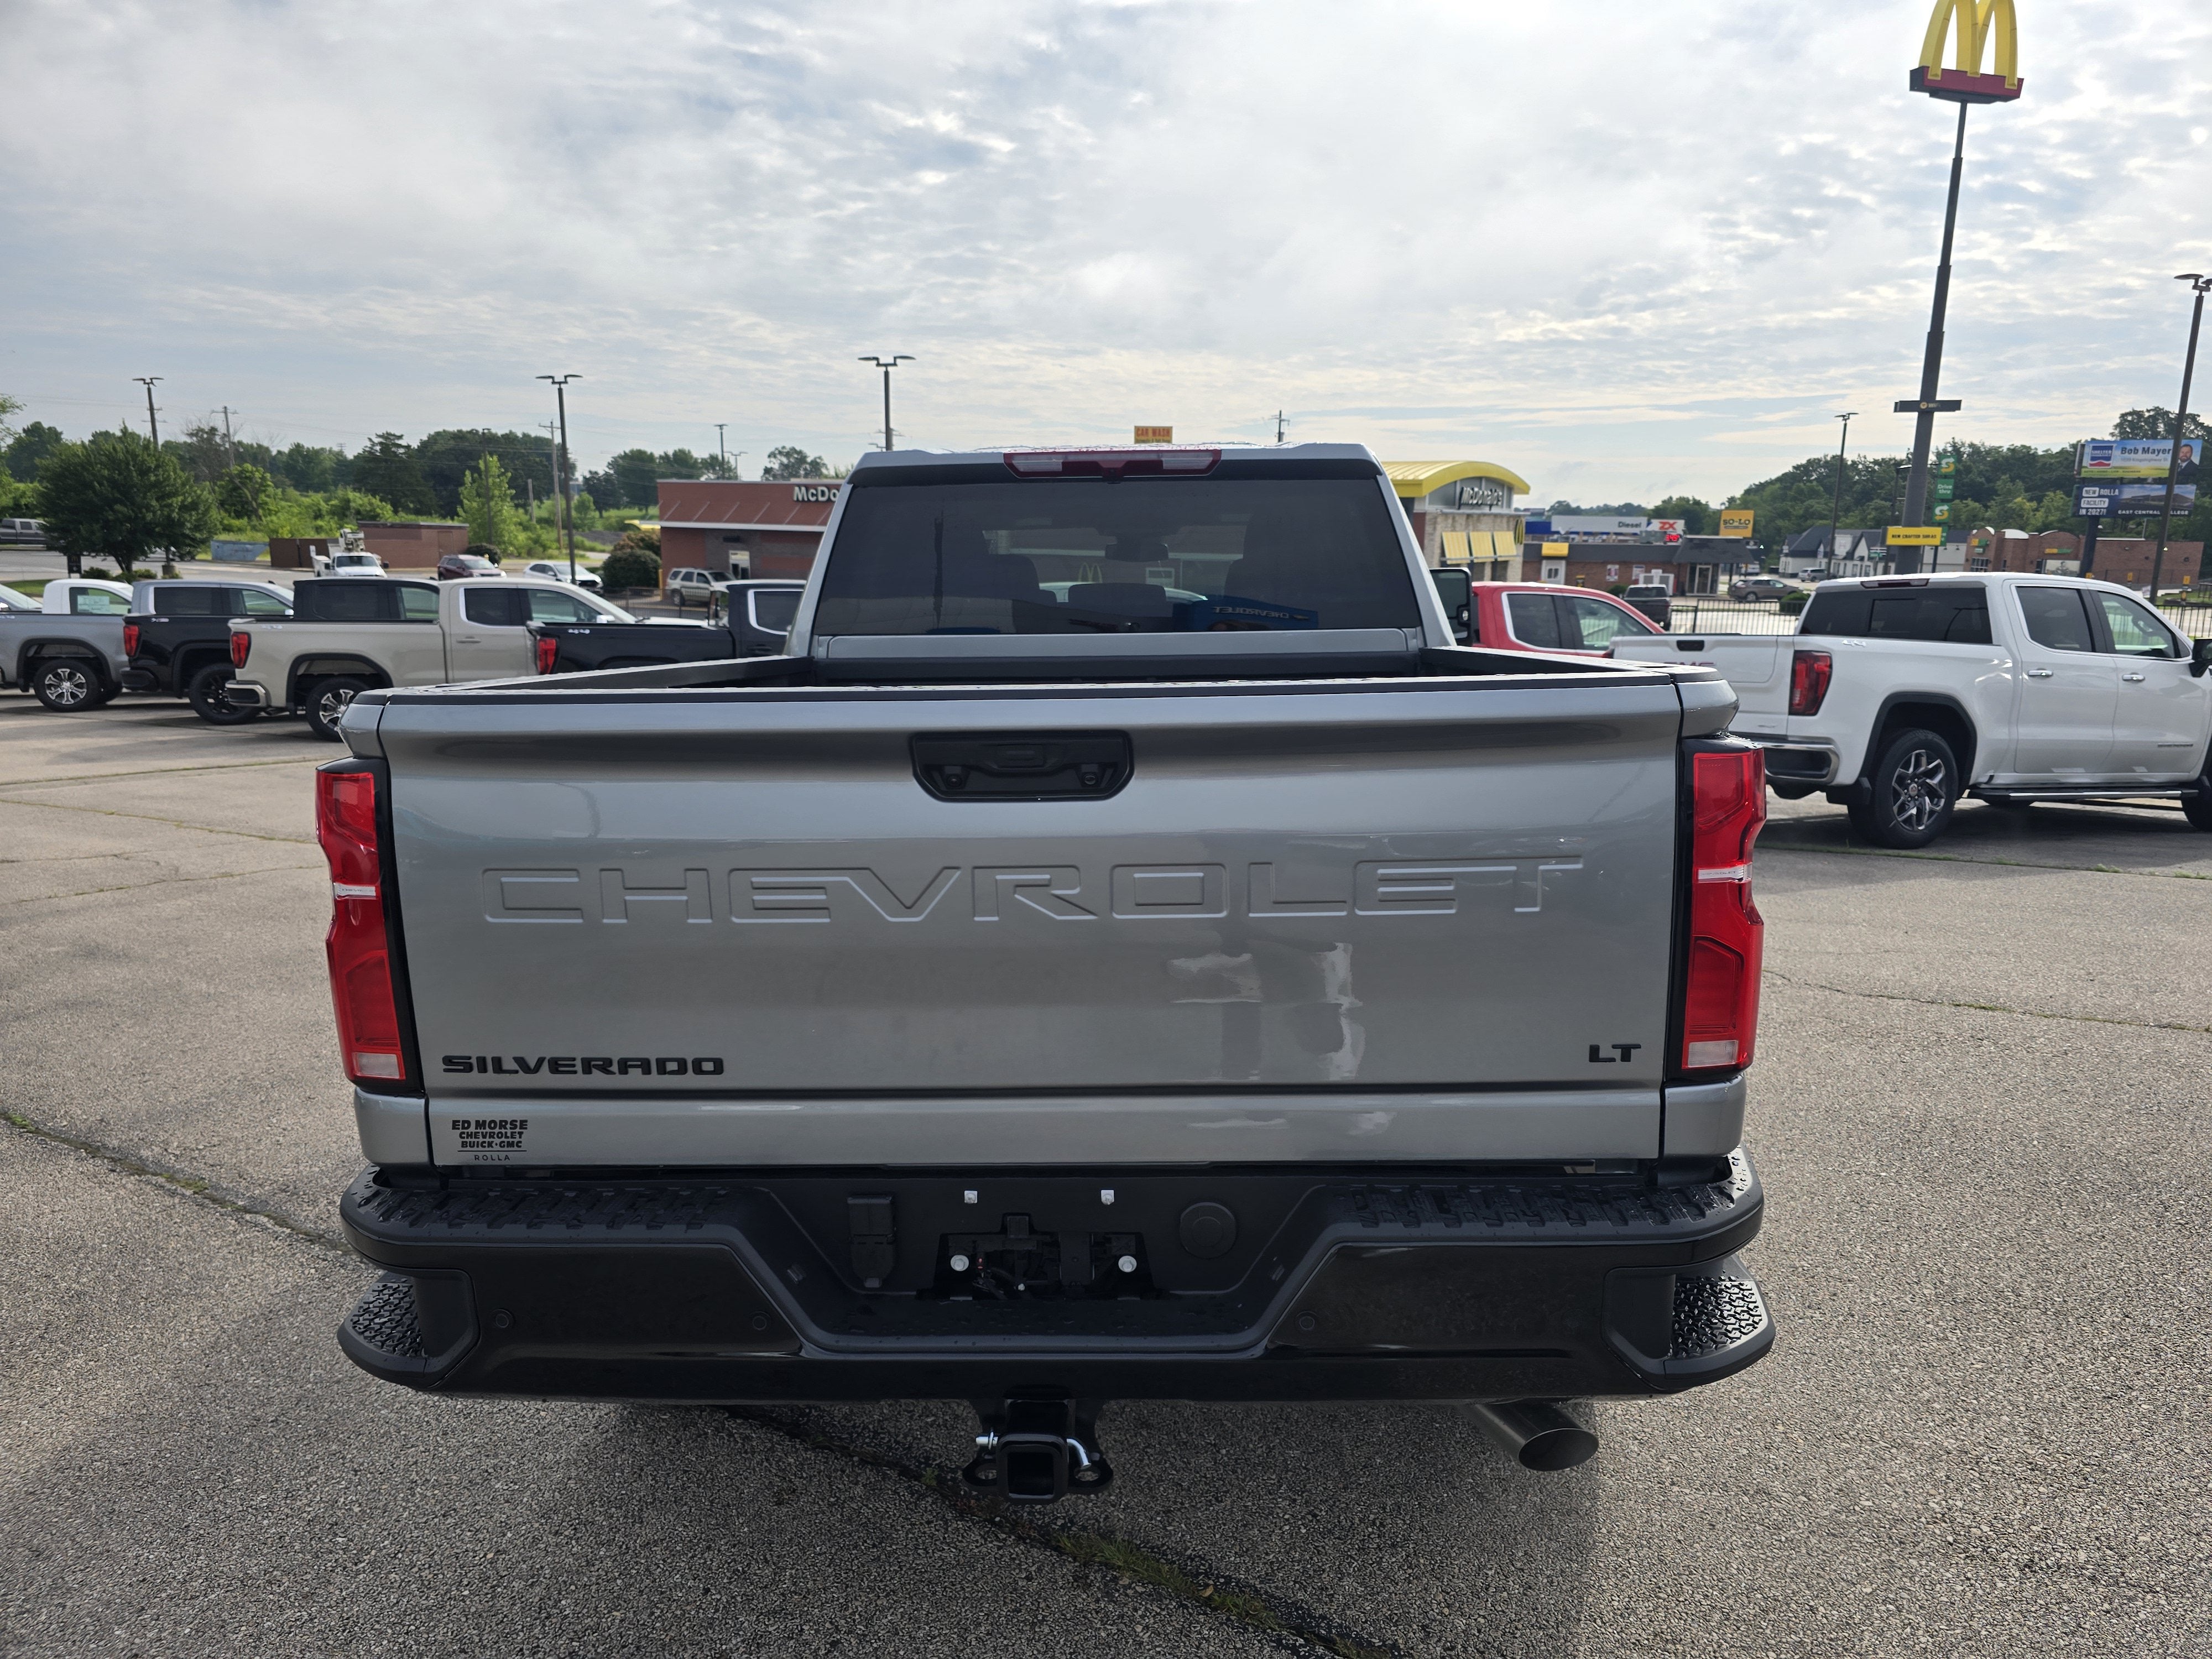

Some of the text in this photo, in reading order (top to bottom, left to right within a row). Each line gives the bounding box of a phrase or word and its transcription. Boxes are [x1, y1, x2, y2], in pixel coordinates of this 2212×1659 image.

[2120, 446, 2172, 456] Bob Mayer
[482, 854, 1584, 923] CHEVROLET
[1589, 1044, 1642, 1063] LT
[442, 1055, 724, 1076] SILVERADO
[452, 1119, 528, 1130] ED MORSE
[459, 1131, 524, 1139] CHEVROLET
